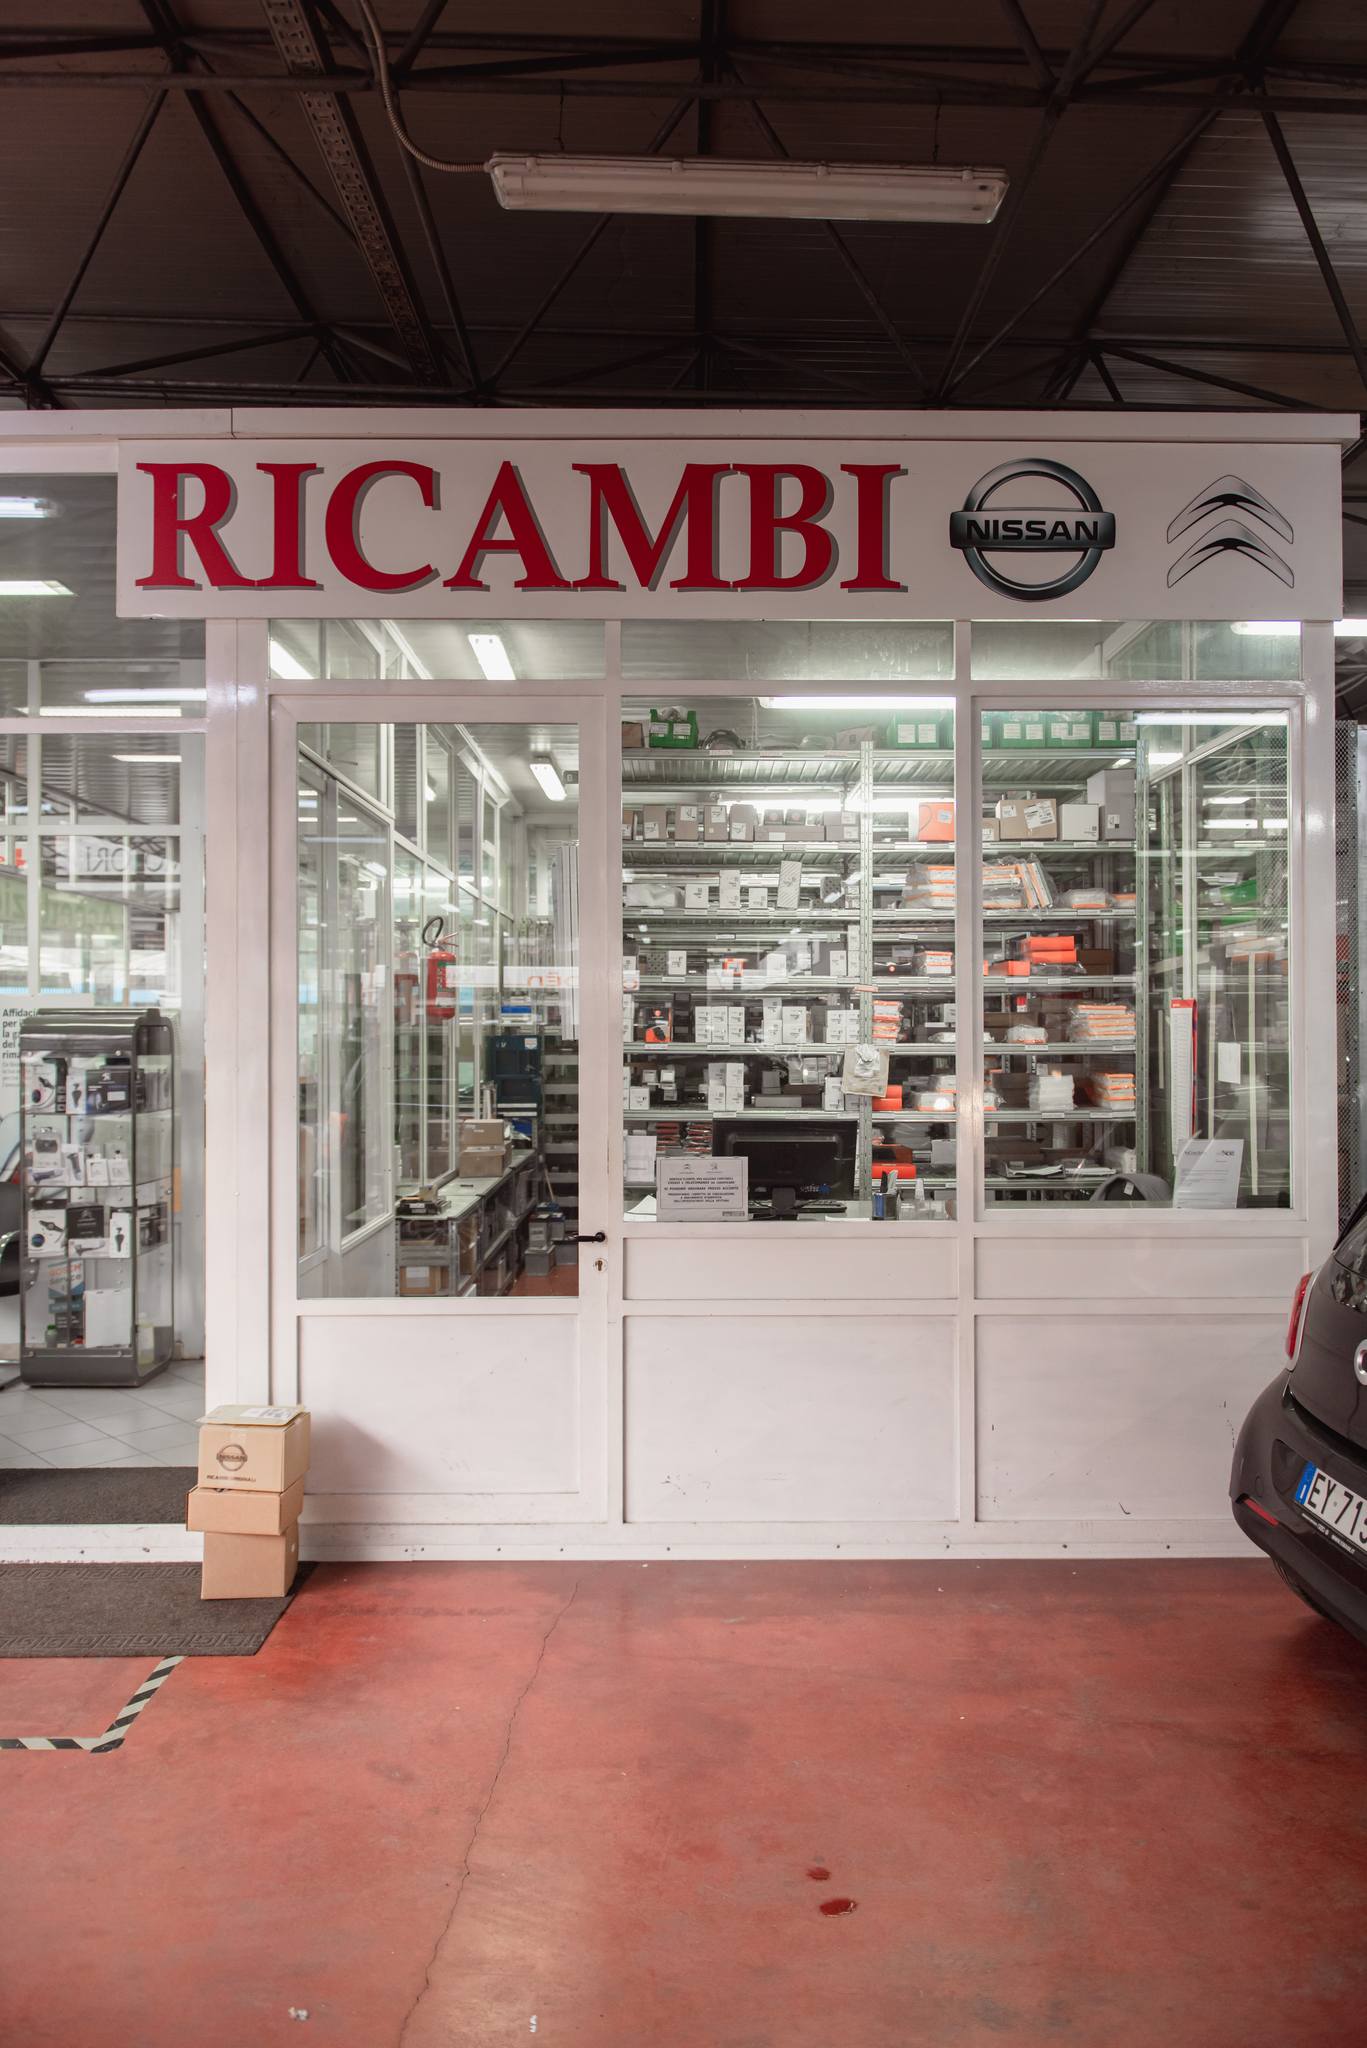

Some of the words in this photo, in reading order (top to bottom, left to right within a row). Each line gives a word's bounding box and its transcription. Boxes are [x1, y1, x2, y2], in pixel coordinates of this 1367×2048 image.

[135, 458, 908, 591] RICAMBI
[966, 519, 1099, 541] NISSAN
[2, 1008, 38, 1017] Affidaci
[2, 1029, 9, 1038] la
[2, 1040, 16, 1048] del
[2, 1051, 20, 1059] rim
